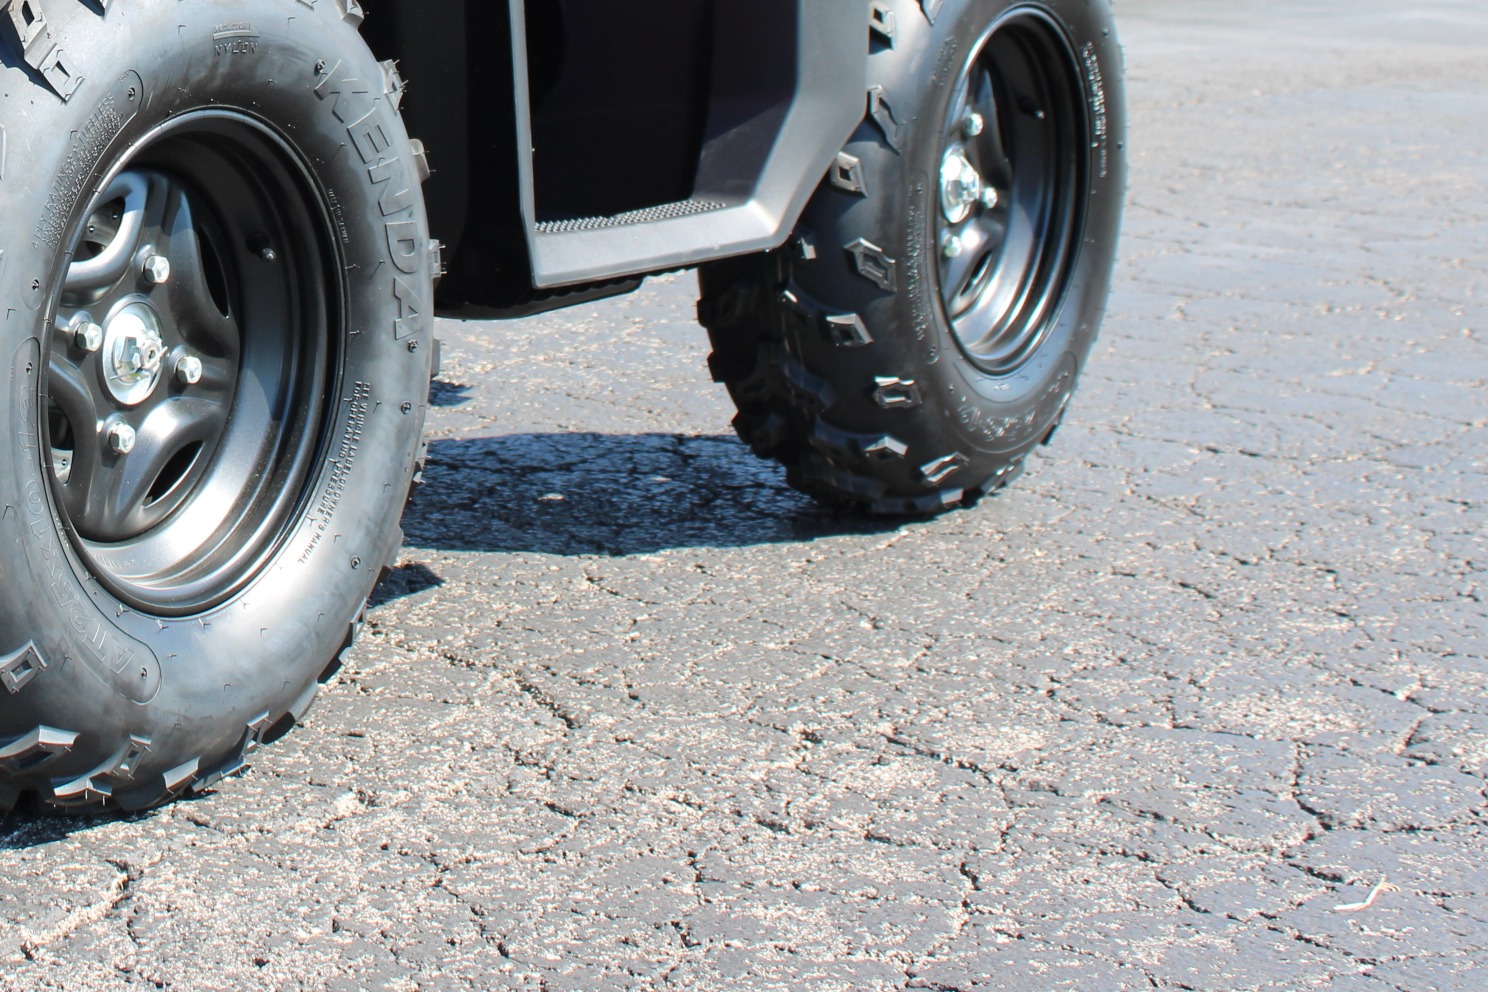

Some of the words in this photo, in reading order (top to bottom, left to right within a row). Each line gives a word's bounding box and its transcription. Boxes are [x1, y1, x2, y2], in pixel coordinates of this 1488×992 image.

[214, 40, 258, 56] NYLON
[35, 214, 47, 239] PLY
[45, 159, 74, 210] RATING
[314, 59, 423, 340] KENDA
[343, 444, 358, 478] LABEL
[317, 462, 343, 513] PRESSURE
[297, 530, 323, 565] MANUAL
